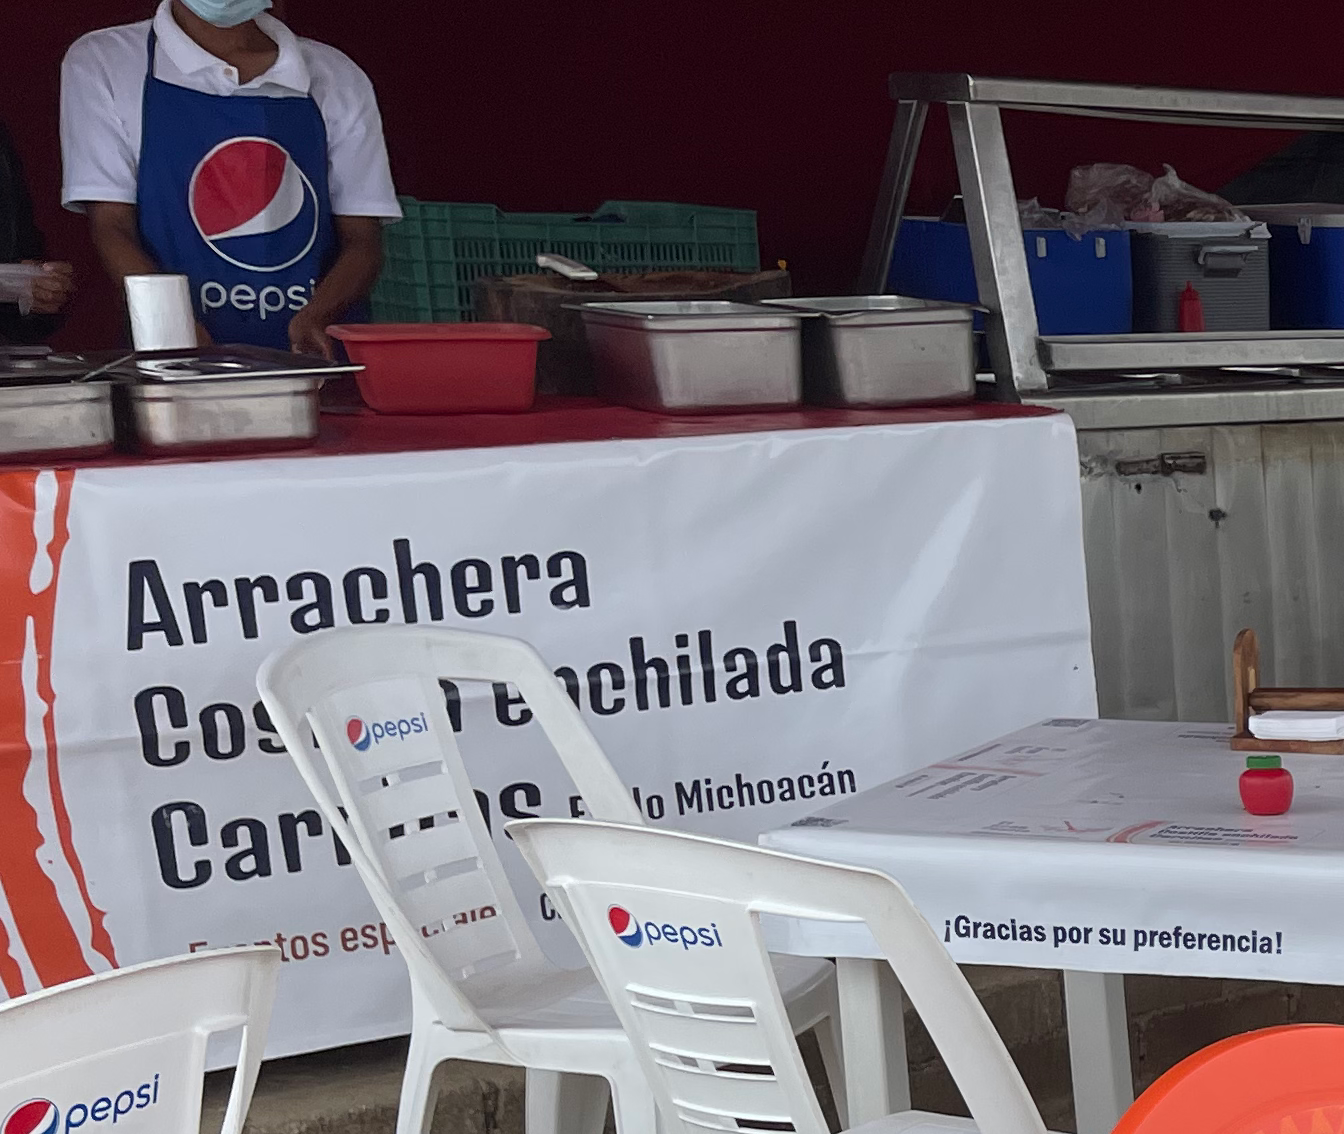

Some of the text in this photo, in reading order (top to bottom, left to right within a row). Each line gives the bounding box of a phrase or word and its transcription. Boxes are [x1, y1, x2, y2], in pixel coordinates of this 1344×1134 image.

[127, 538, 590, 651] Arrachera
[373, 712, 428, 743] pepsi
[675, 760, 857, 816] Michoacán
[645, 921, 723, 950] pepsi
[944, 915, 1283, 955] ¡Gracias por su preferencia!
